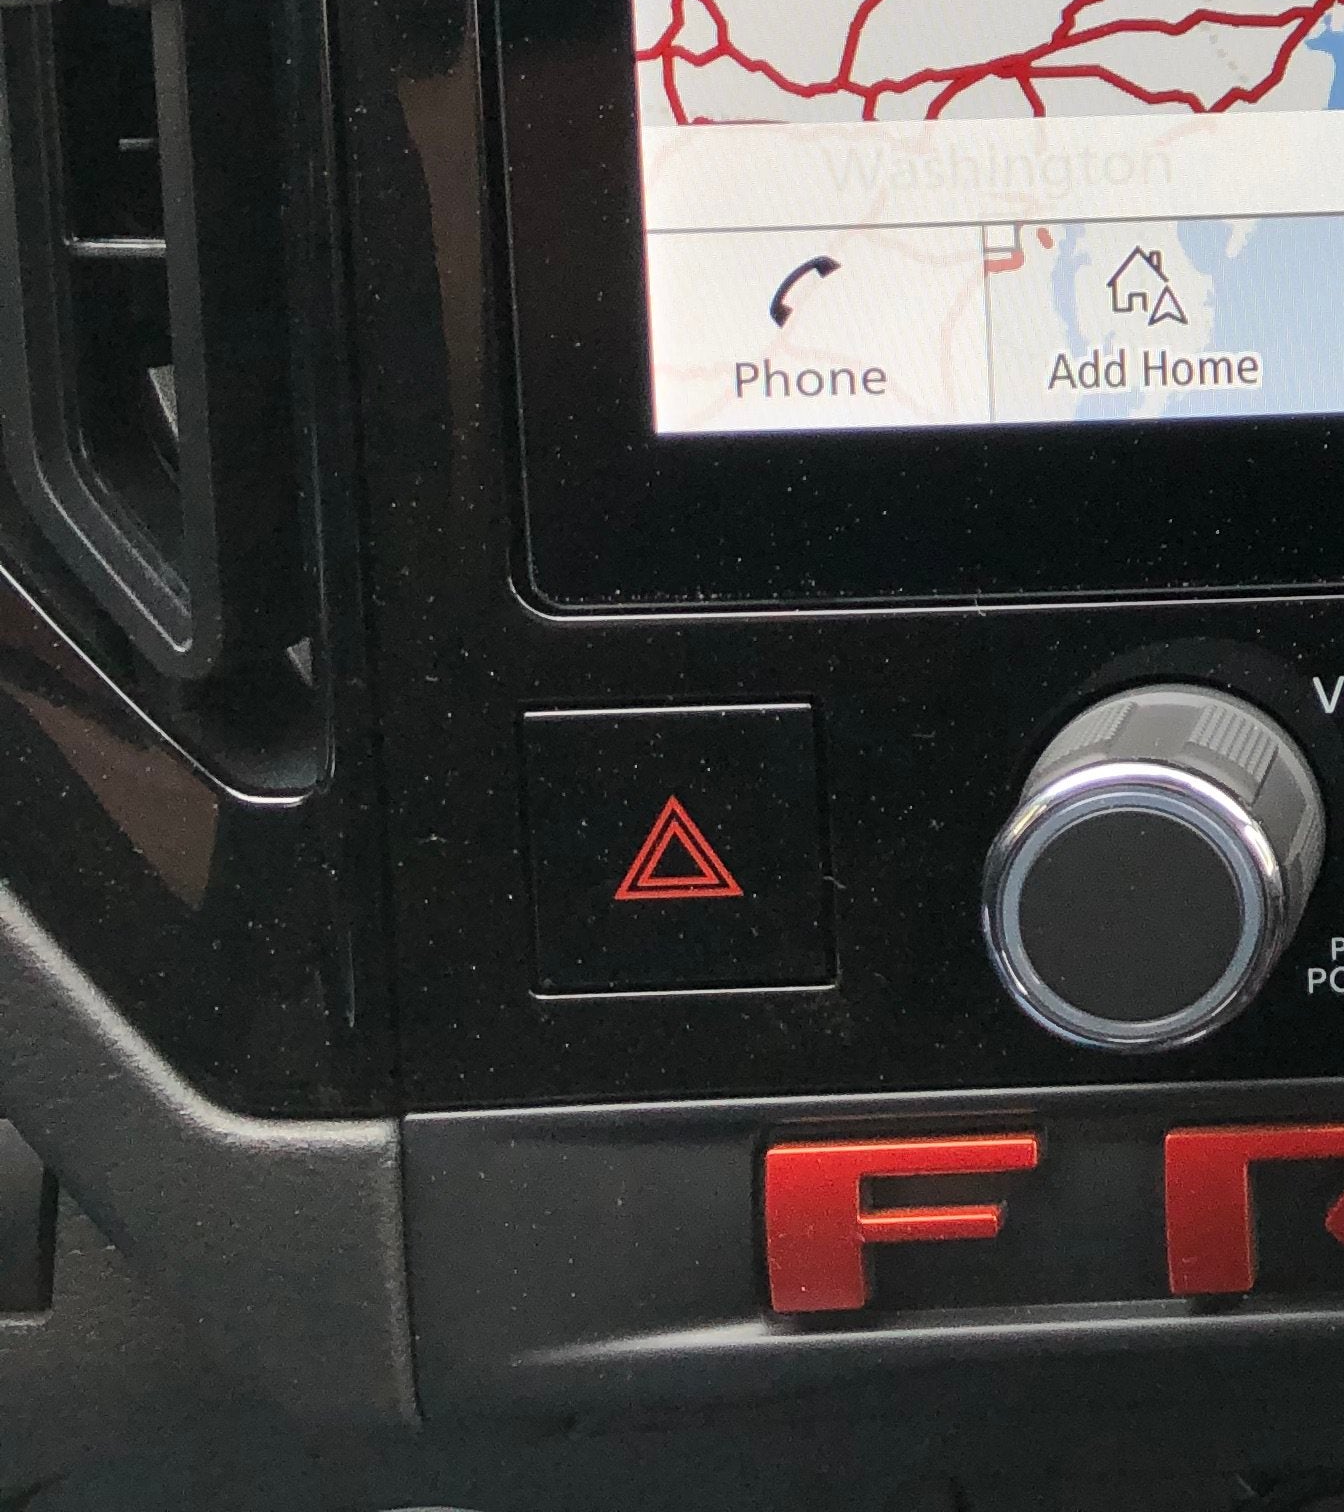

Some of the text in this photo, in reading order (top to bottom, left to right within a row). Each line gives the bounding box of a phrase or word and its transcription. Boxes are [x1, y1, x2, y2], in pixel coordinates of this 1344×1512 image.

[735, 358, 888, 399] Phone
[1048, 349, 1260, 391] Add Home
